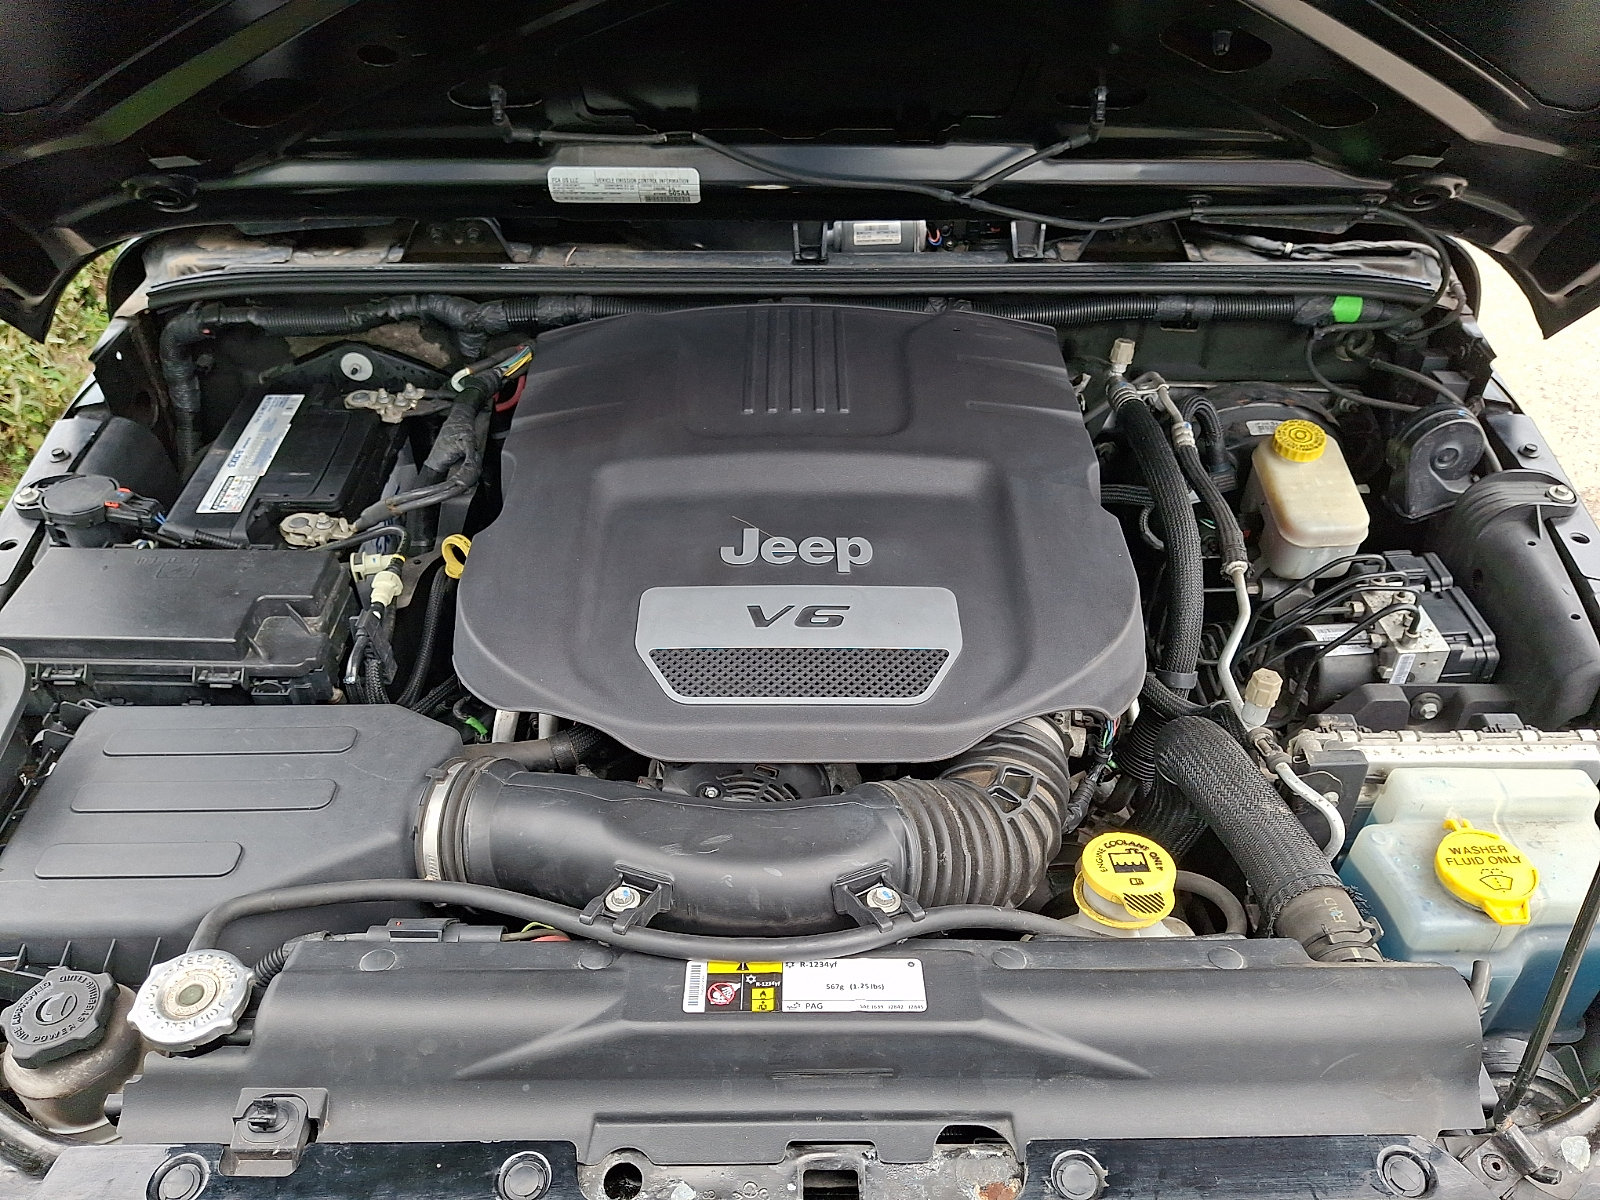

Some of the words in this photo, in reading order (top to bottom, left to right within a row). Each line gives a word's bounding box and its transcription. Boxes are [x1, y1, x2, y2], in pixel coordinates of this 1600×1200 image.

[720, 528, 874, 573] Jeep
[746, 605, 850, 628] V6
[1096, 848, 1108, 872] ENGINE
[1104, 840, 1150, 851] COOLANT
[1149, 852, 1164, 872] ONLY
[1448, 845, 1508, 855] WASHER
[1446, 856, 1485, 866] FLUID
[1488, 855, 1522, 865] ONLY
[176, 954, 214, 972] KEEP
[32, 1024, 76, 1042] POWER
